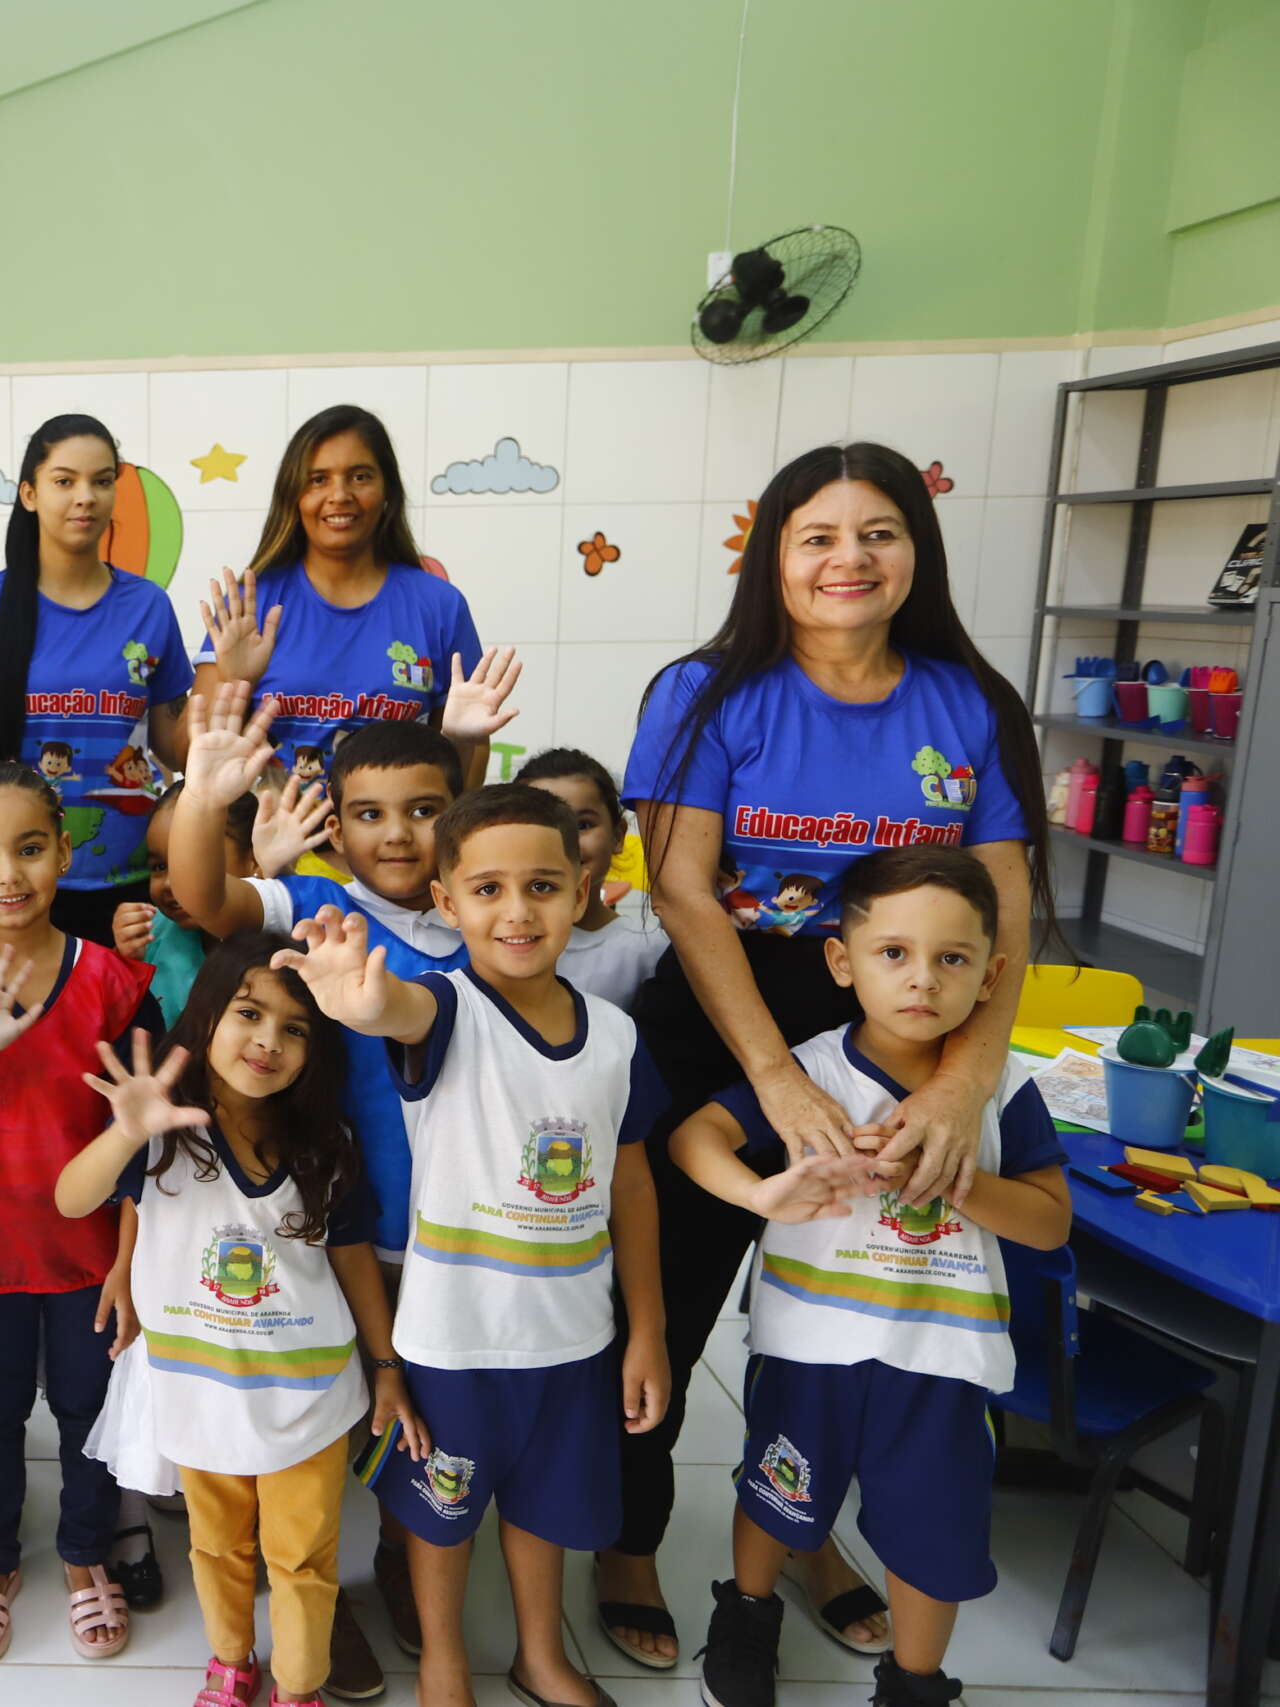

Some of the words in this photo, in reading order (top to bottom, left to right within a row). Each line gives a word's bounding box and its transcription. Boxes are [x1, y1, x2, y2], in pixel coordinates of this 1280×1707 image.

[25, 688, 96, 718] ucação
[490, 742, 527, 781] T
[735, 806, 870, 848] Educação
[873, 816, 963, 848] Infanti
[472, 1202, 503, 1218] PARA
[505, 1210, 569, 1225] CONTINUAR
[835, 1249, 869, 1260] PARA
[163, 1305, 192, 1316] PARA
[193, 1308, 252, 1328] CONTINUAR
[253, 1316, 314, 1329] AVANÇANDO
